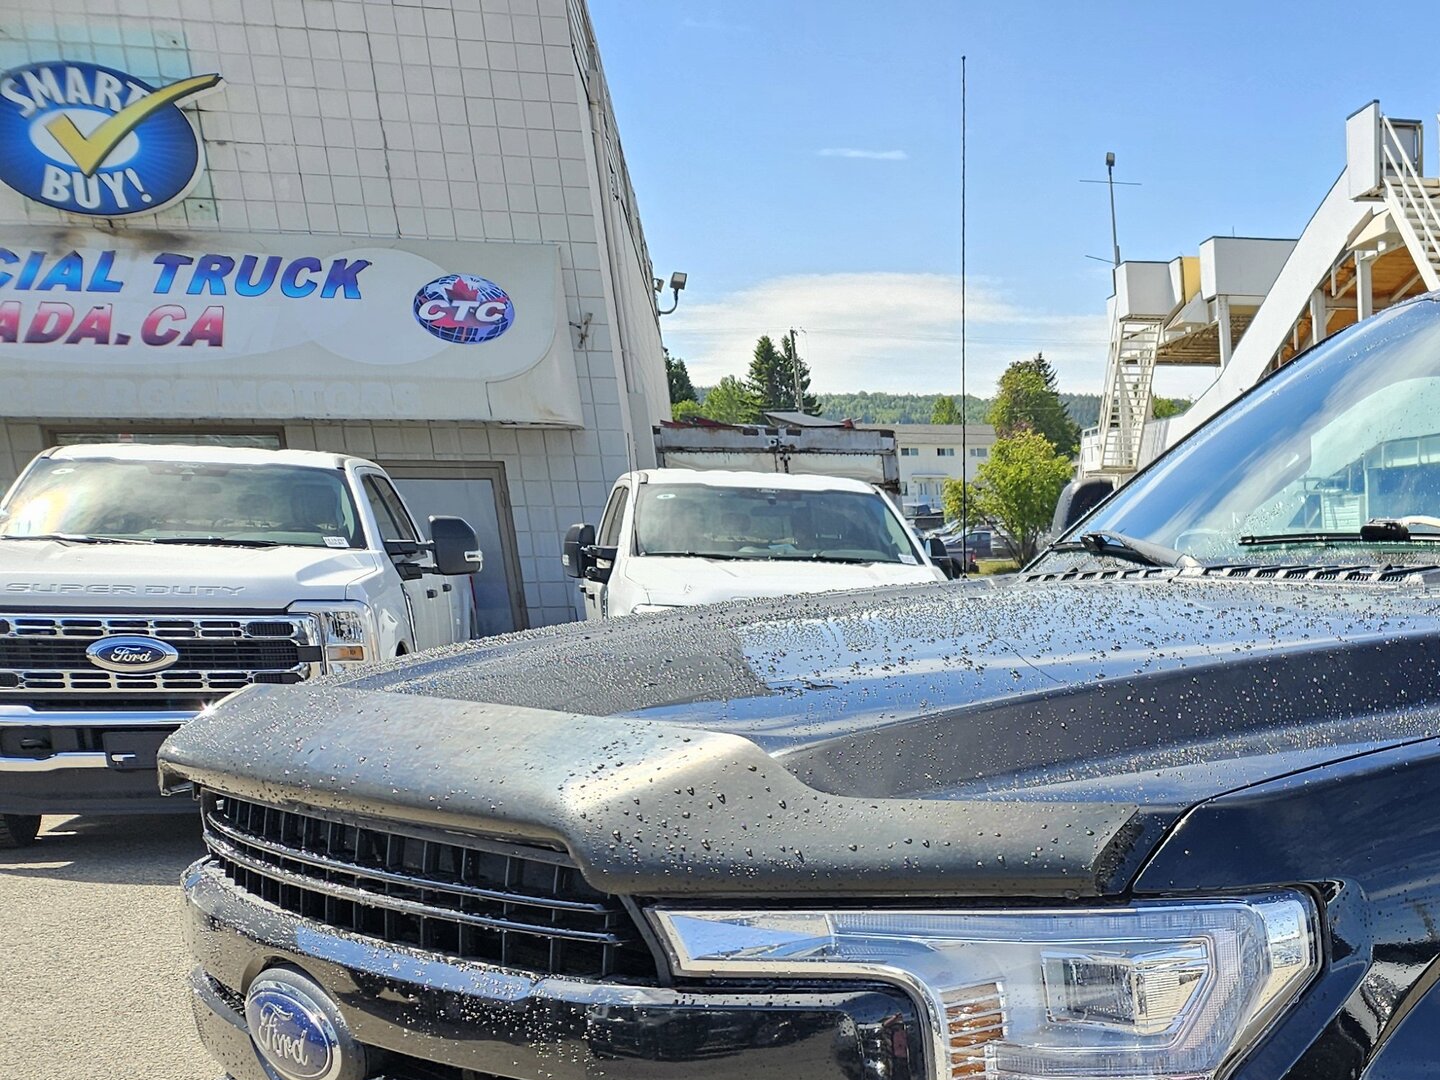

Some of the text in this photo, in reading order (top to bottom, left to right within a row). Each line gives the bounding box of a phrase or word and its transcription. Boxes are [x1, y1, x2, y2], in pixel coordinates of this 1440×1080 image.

[0, 66, 150, 118] SMART
[41, 164, 152, 209] BUY!
[153, 252, 371, 299] TRUCK
[418, 299, 507, 323] CTC
[6, 582, 246, 596] SUPER DUTY
[110, 646, 152, 663] Ford
[258, 1001, 309, 1067] Ford
